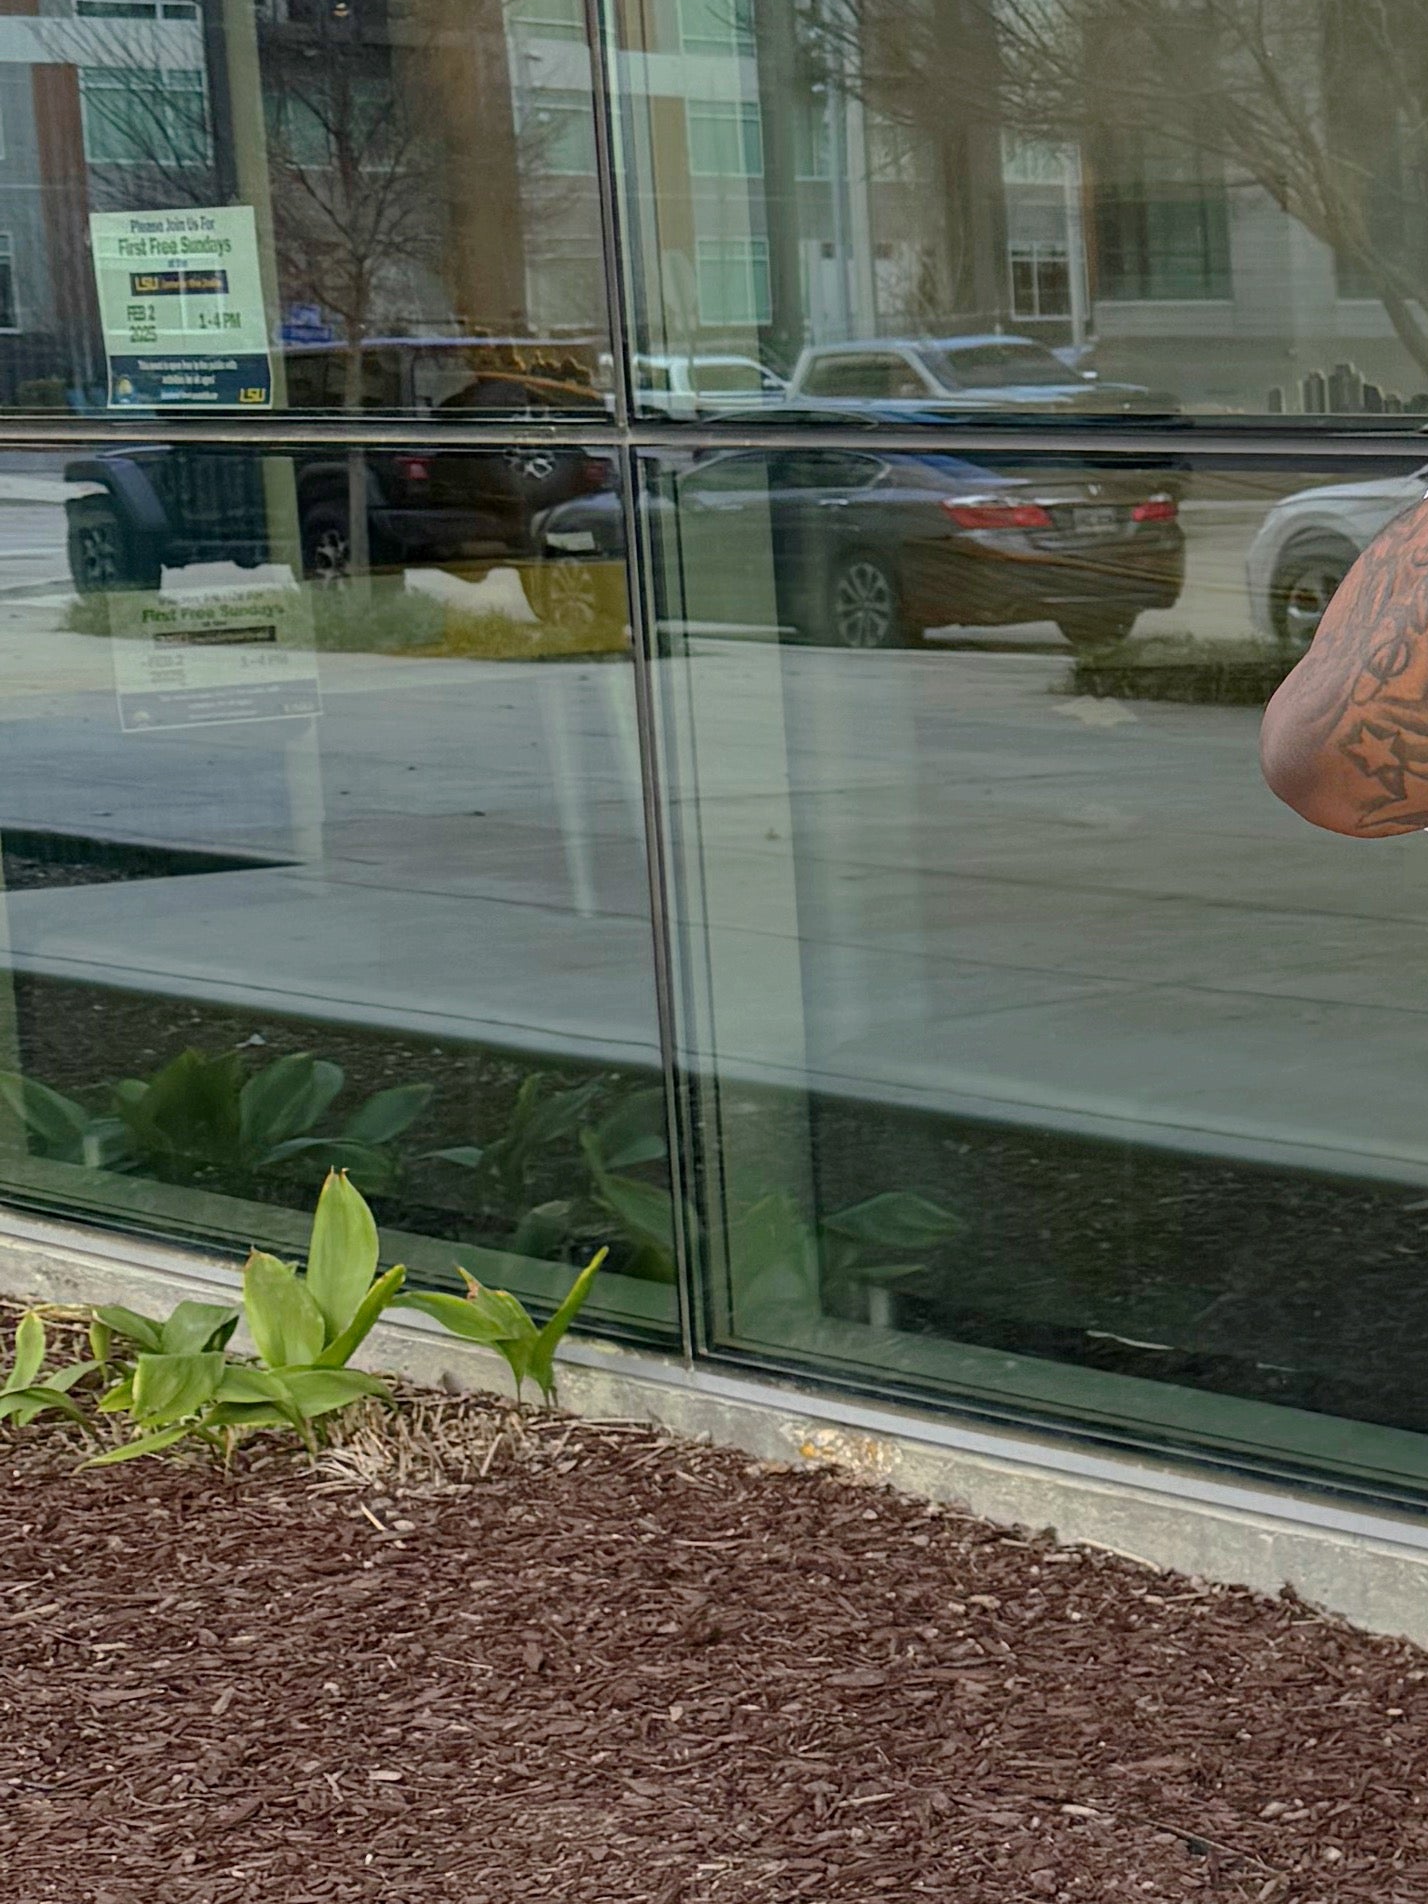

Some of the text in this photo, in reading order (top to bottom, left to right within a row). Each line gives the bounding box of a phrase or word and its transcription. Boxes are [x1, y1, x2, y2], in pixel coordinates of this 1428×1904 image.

[118, 235, 232, 257] First Free Sundays
[135, 275, 159, 291] LSU
[127, 304, 156, 321] FEB 2
[223, 312, 242, 329] PM
[239, 388, 266, 403] LSU
